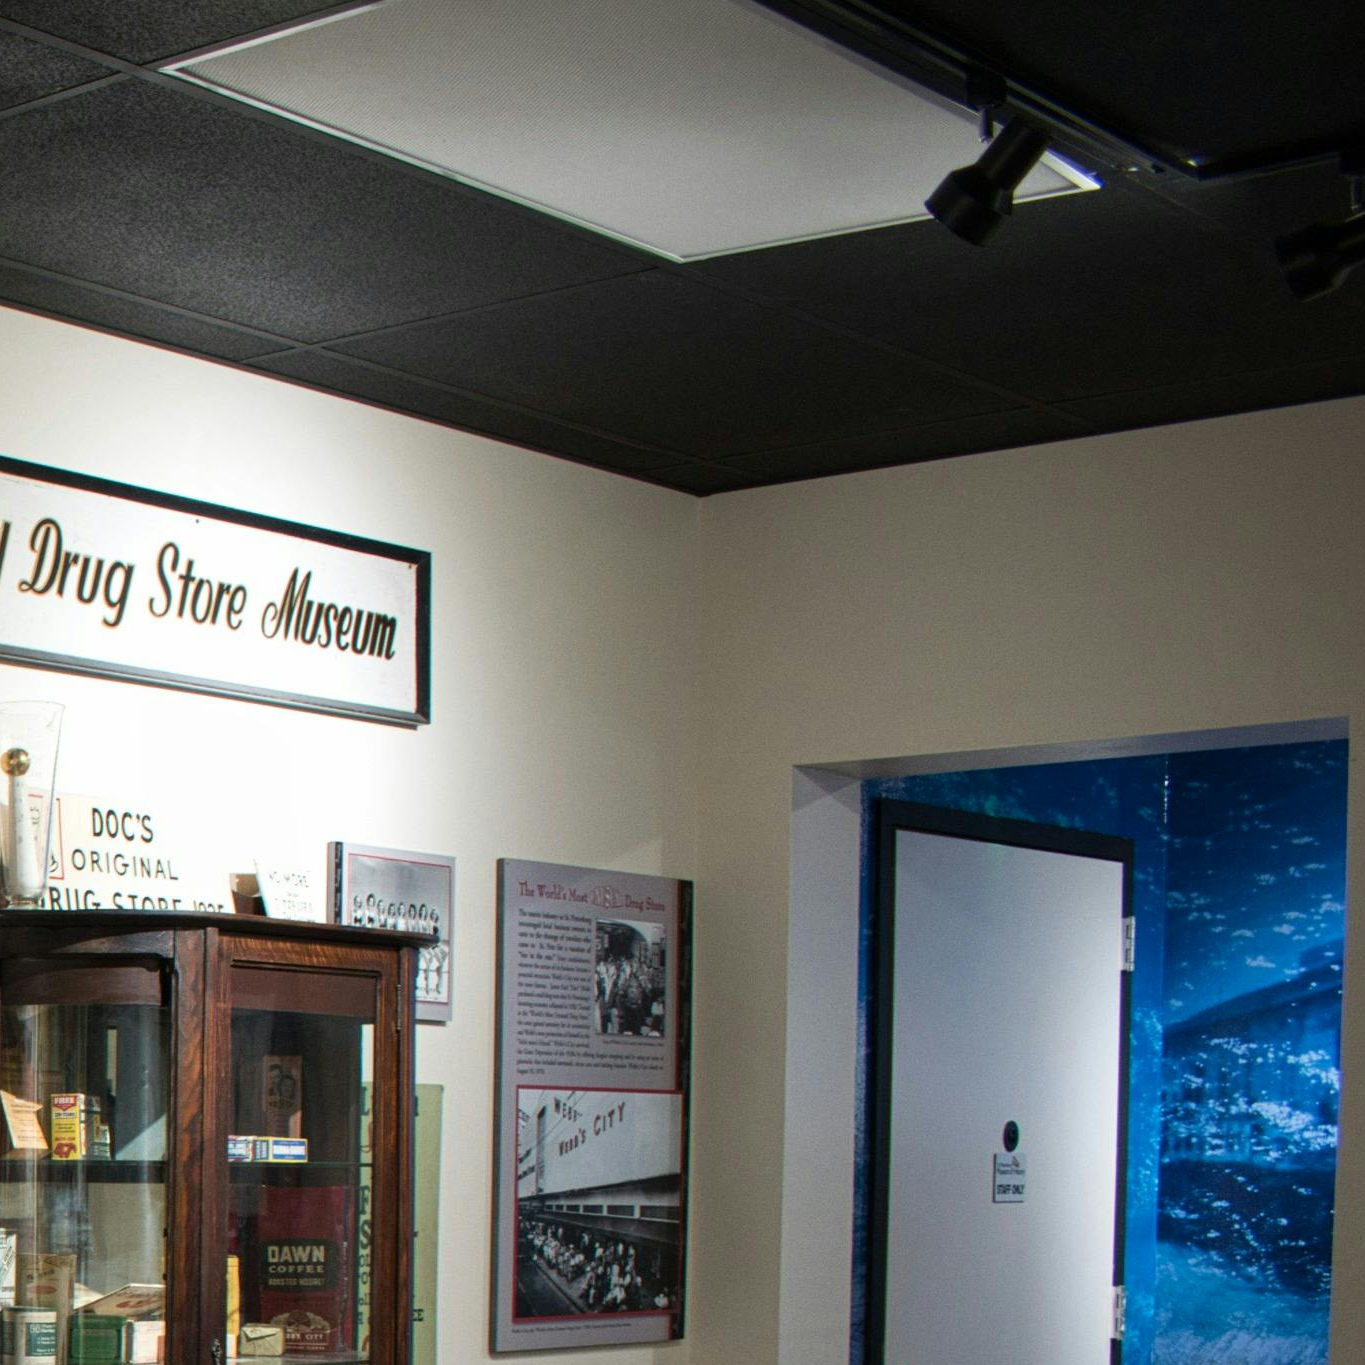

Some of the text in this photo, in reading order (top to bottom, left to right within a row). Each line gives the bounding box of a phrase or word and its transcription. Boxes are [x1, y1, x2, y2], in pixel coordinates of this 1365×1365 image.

[17, 516, 135, 629] Drug
[147, 541, 248, 633] Store
[260, 565, 397, 663] Museum
[91, 807, 155, 844] DOC'S
[70, 848, 180, 882] ORIGINAL
[518, 880, 534, 898] The
[592, 1102, 626, 1136] CITY
[267, 1245, 325, 1263] DAWN
[269, 1264, 325, 1274] COFFEE
